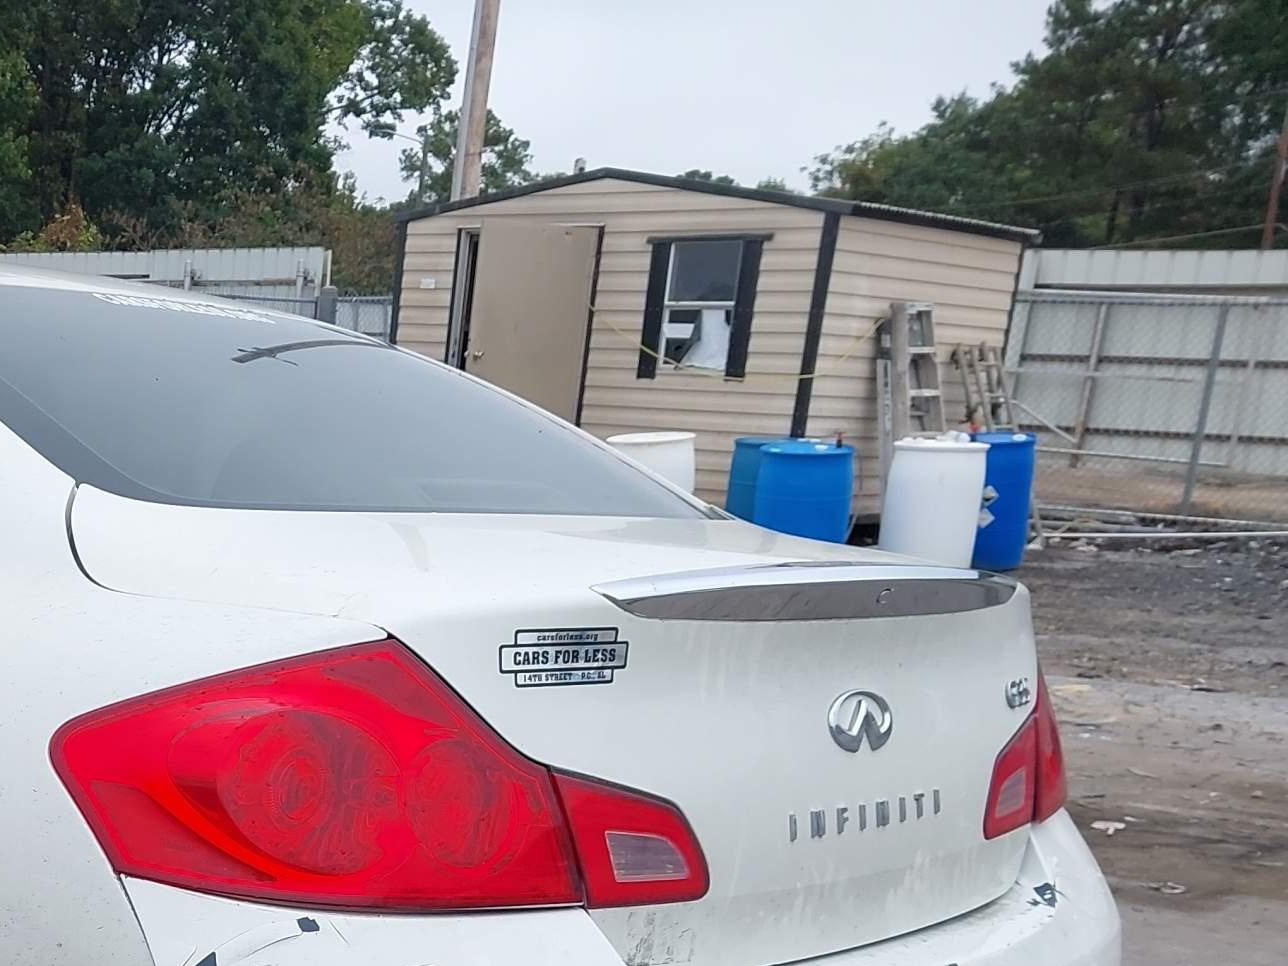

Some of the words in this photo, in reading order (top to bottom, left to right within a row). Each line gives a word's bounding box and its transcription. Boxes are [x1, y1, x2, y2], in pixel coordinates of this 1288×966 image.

[537, 632, 599, 642] carsforless.org
[513, 650, 550, 667] CARS
[554, 649, 580, 665] FOR
[584, 648, 617, 664] LESS
[544, 672, 573, 682] STREET
[788, 788, 941, 843] INFINITI
